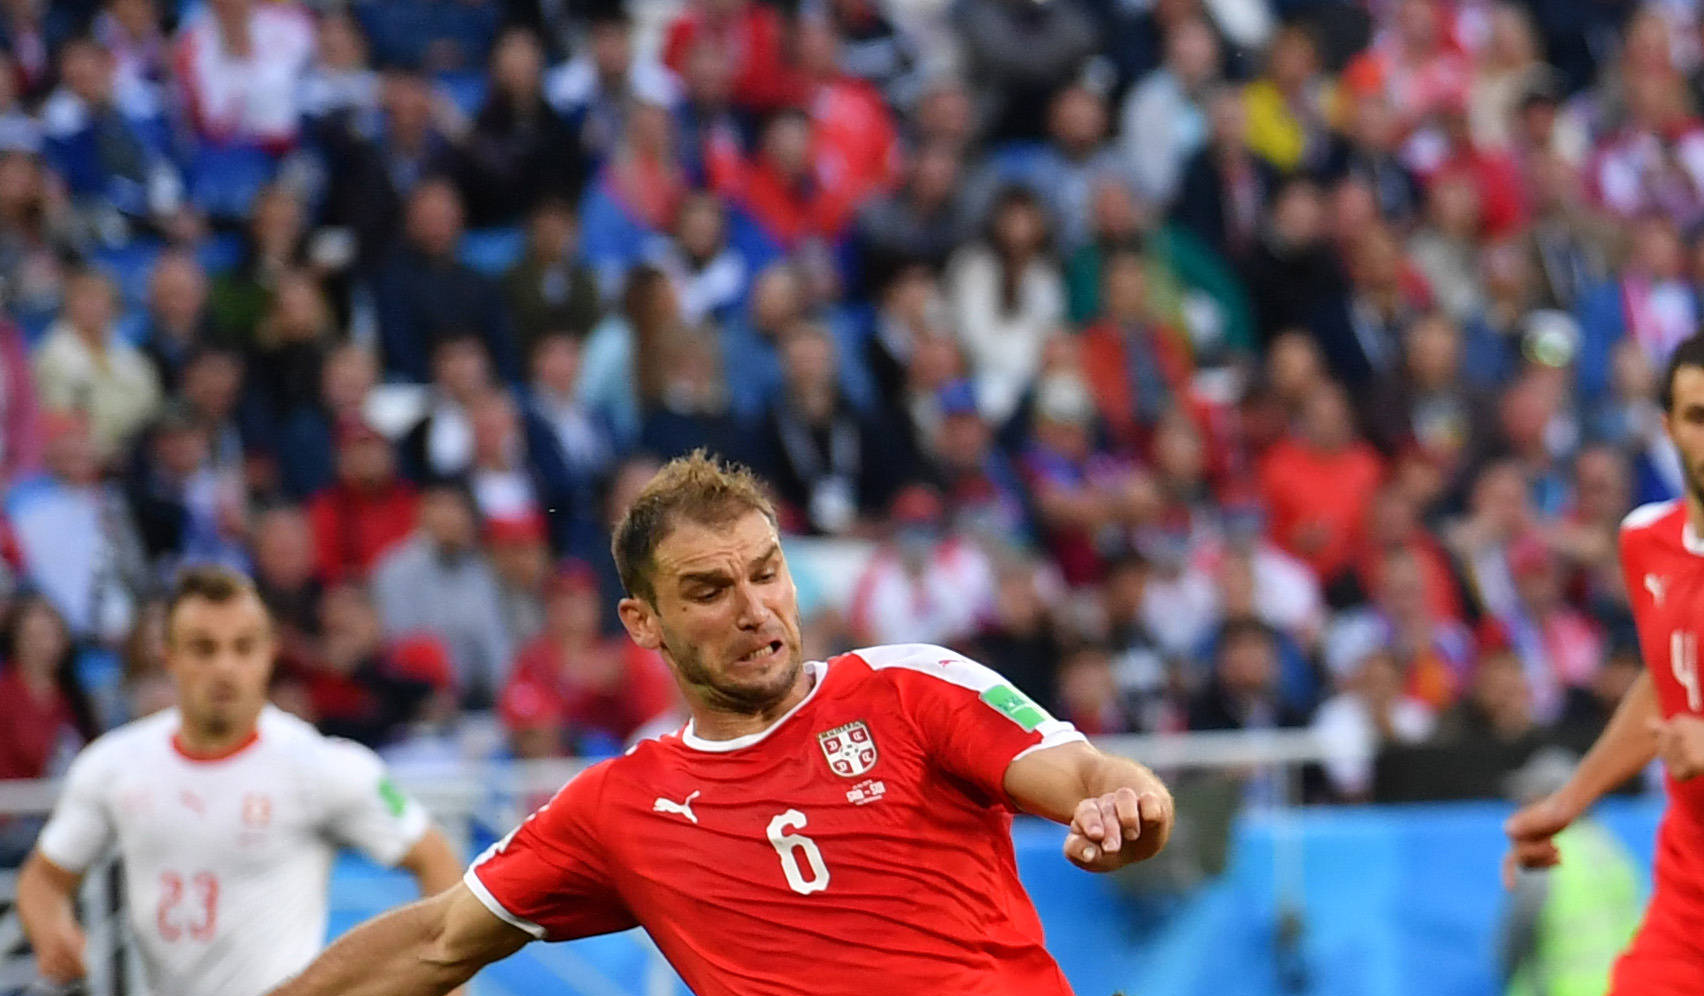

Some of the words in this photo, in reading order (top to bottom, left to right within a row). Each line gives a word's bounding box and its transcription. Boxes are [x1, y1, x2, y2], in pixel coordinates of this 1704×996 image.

[1670, 629, 1702, 713] 4
[765, 808, 831, 896] 6
[156, 869, 220, 942] 23
